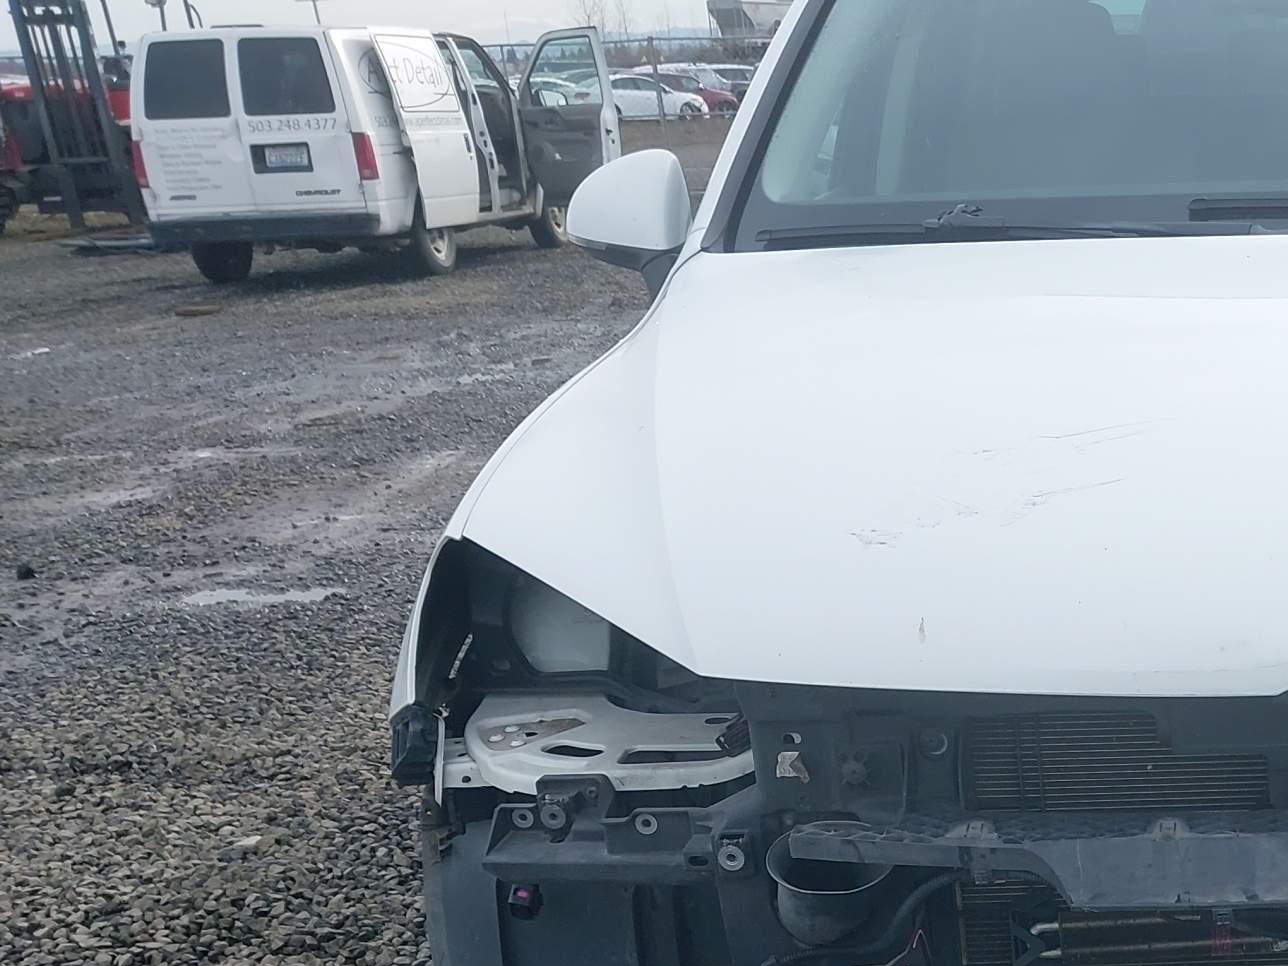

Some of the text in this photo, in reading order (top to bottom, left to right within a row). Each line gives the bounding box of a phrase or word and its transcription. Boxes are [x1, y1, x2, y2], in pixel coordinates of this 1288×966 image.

[247, 117, 337, 133] 503 248 4377
